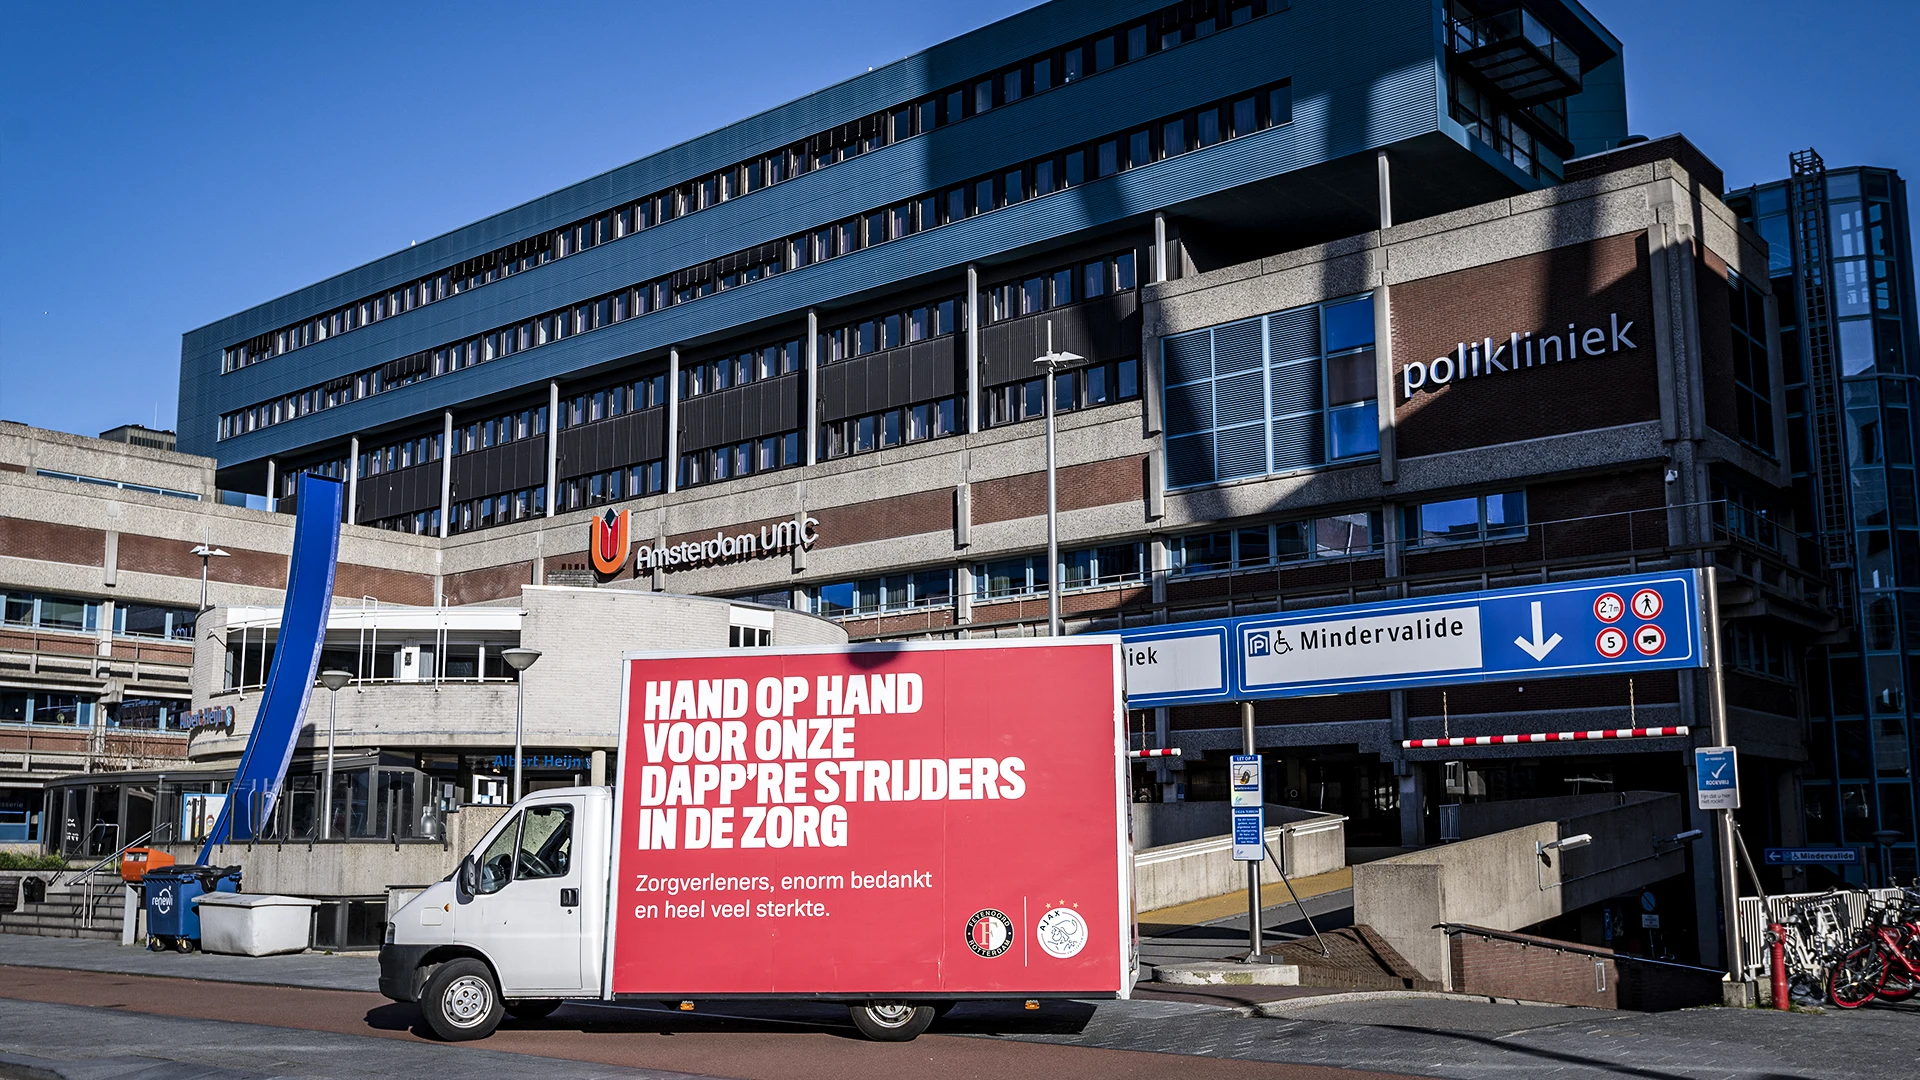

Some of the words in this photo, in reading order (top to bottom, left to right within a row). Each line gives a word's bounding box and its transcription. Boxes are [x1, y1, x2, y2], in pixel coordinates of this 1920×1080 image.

[1403, 312, 1637, 399] polikliniek
[637, 531, 756, 570] Amsterdam
[1301, 616, 1464, 651] Mindervalide
[1607, 636, 1616, 649] 5
[1129, 647, 1158, 666] iek
[644, 678, 749, 721] HAND
[755, 676, 810, 719] OP
[816, 672, 924, 717] HAND
[180, 709, 204, 729] Albert
[203, 704, 225, 728] Heijn
[643, 720, 748, 763] VOOR
[754, 717, 856, 761] ONZE
[493, 754, 539, 768] Albert
[543, 754, 581, 770] Heijn
[640, 762, 808, 807] DAPP'RE
[813, 756, 1027, 804] STRIJDERS
[638, 808, 678, 850] IN
[684, 807, 735, 850] DE
[740, 804, 848, 849] ZORG
[1800, 852, 1854, 861] Mindervalide
[635, 873, 775, 896] Zorgverleners,
[781, 874, 844, 891] enorm
[851, 869, 933, 889] bedankt
[151, 896, 173, 906] renewi
[634, 904, 658, 919] en
[664, 900, 705, 918] heel
[711, 899, 750, 918] veel
[755, 898, 830, 918] sterkte.
[968, 909, 1010, 928] FEYENOORD
[1039, 909, 1061, 932] AJAX
[968, 939, 1011, 957] ROTTERDAM
